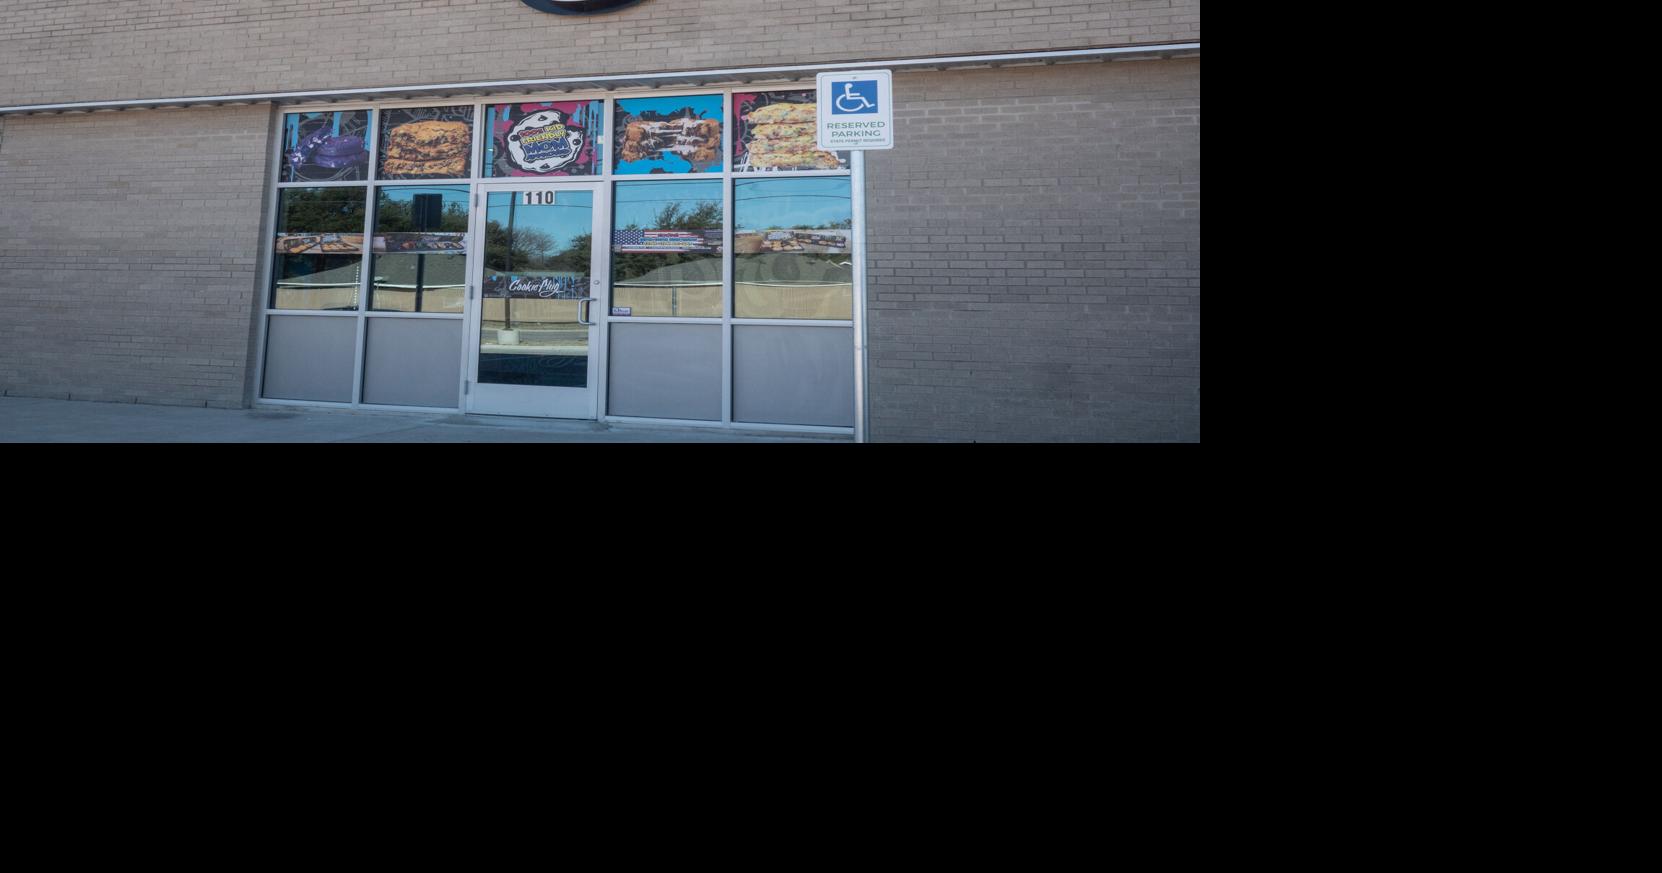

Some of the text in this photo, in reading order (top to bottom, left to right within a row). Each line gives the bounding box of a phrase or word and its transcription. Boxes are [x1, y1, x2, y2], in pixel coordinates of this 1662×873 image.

[543, 123, 565, 133] KID
[827, 121, 886, 130] RESERVED
[521, 129, 567, 145] FRIENDLY
[831, 130, 881, 138] PARKING
[523, 137, 570, 155] MOM
[525, 191, 554, 205] 110
[509, 278, 564, 297] Cookie Plug
